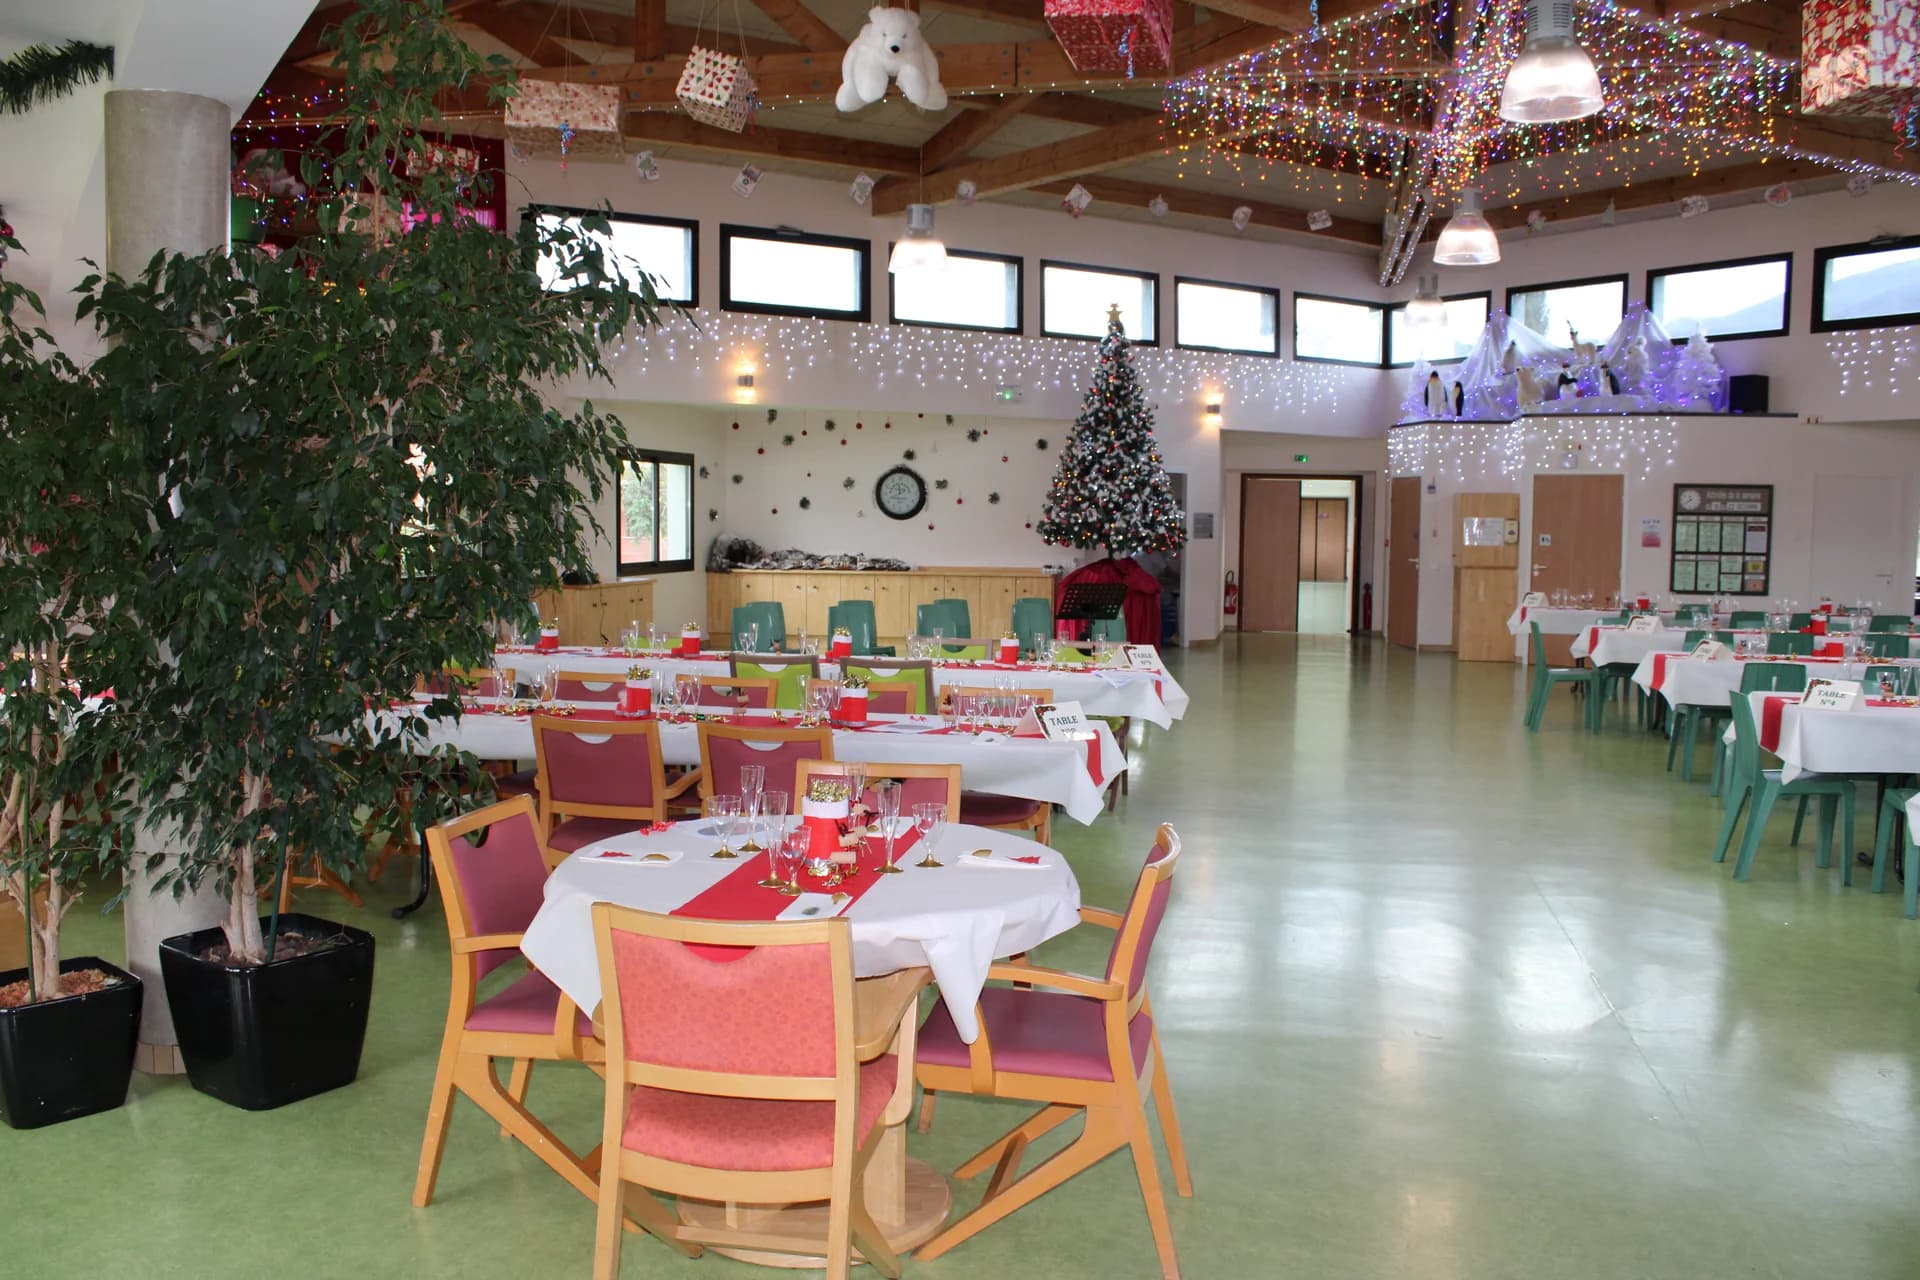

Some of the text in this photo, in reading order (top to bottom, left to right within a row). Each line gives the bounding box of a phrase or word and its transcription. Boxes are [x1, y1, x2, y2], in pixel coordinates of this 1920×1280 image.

[1132, 651, 1153, 660] TABLE
[1817, 690, 1847, 699] TABLE
[1049, 714, 1079, 726] TABLE
